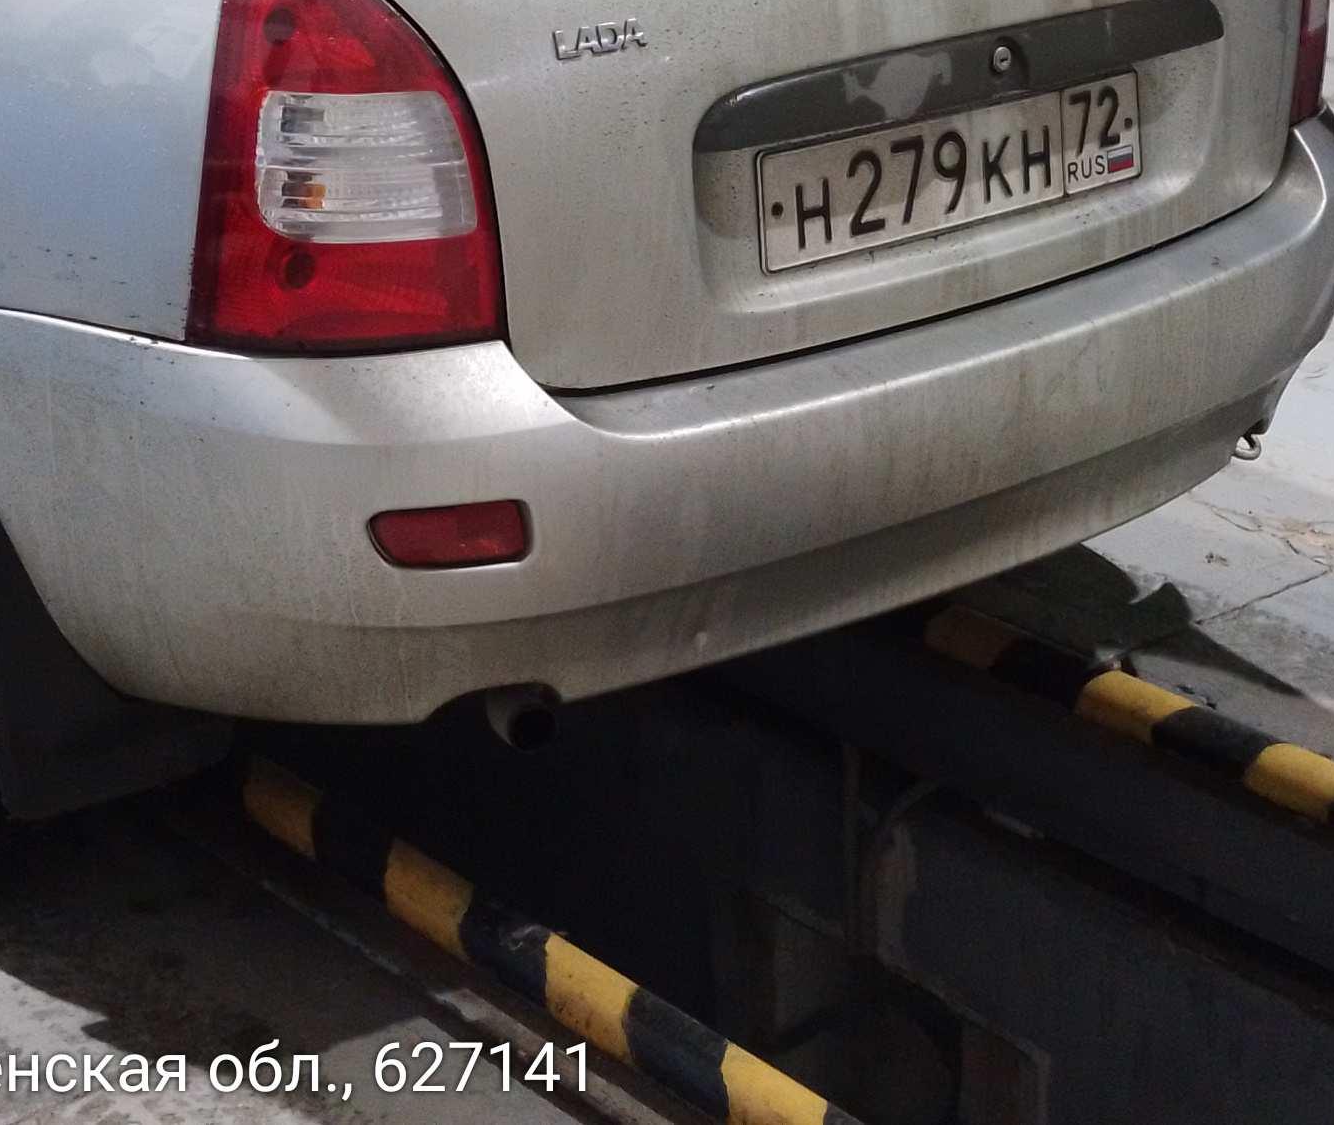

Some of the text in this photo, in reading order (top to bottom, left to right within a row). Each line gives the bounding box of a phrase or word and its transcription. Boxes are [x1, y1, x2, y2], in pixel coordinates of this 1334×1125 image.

[552, 18, 647, 61] LADA
[1068, 85, 1122, 158] 72
[1067, 154, 1106, 184] RUS
